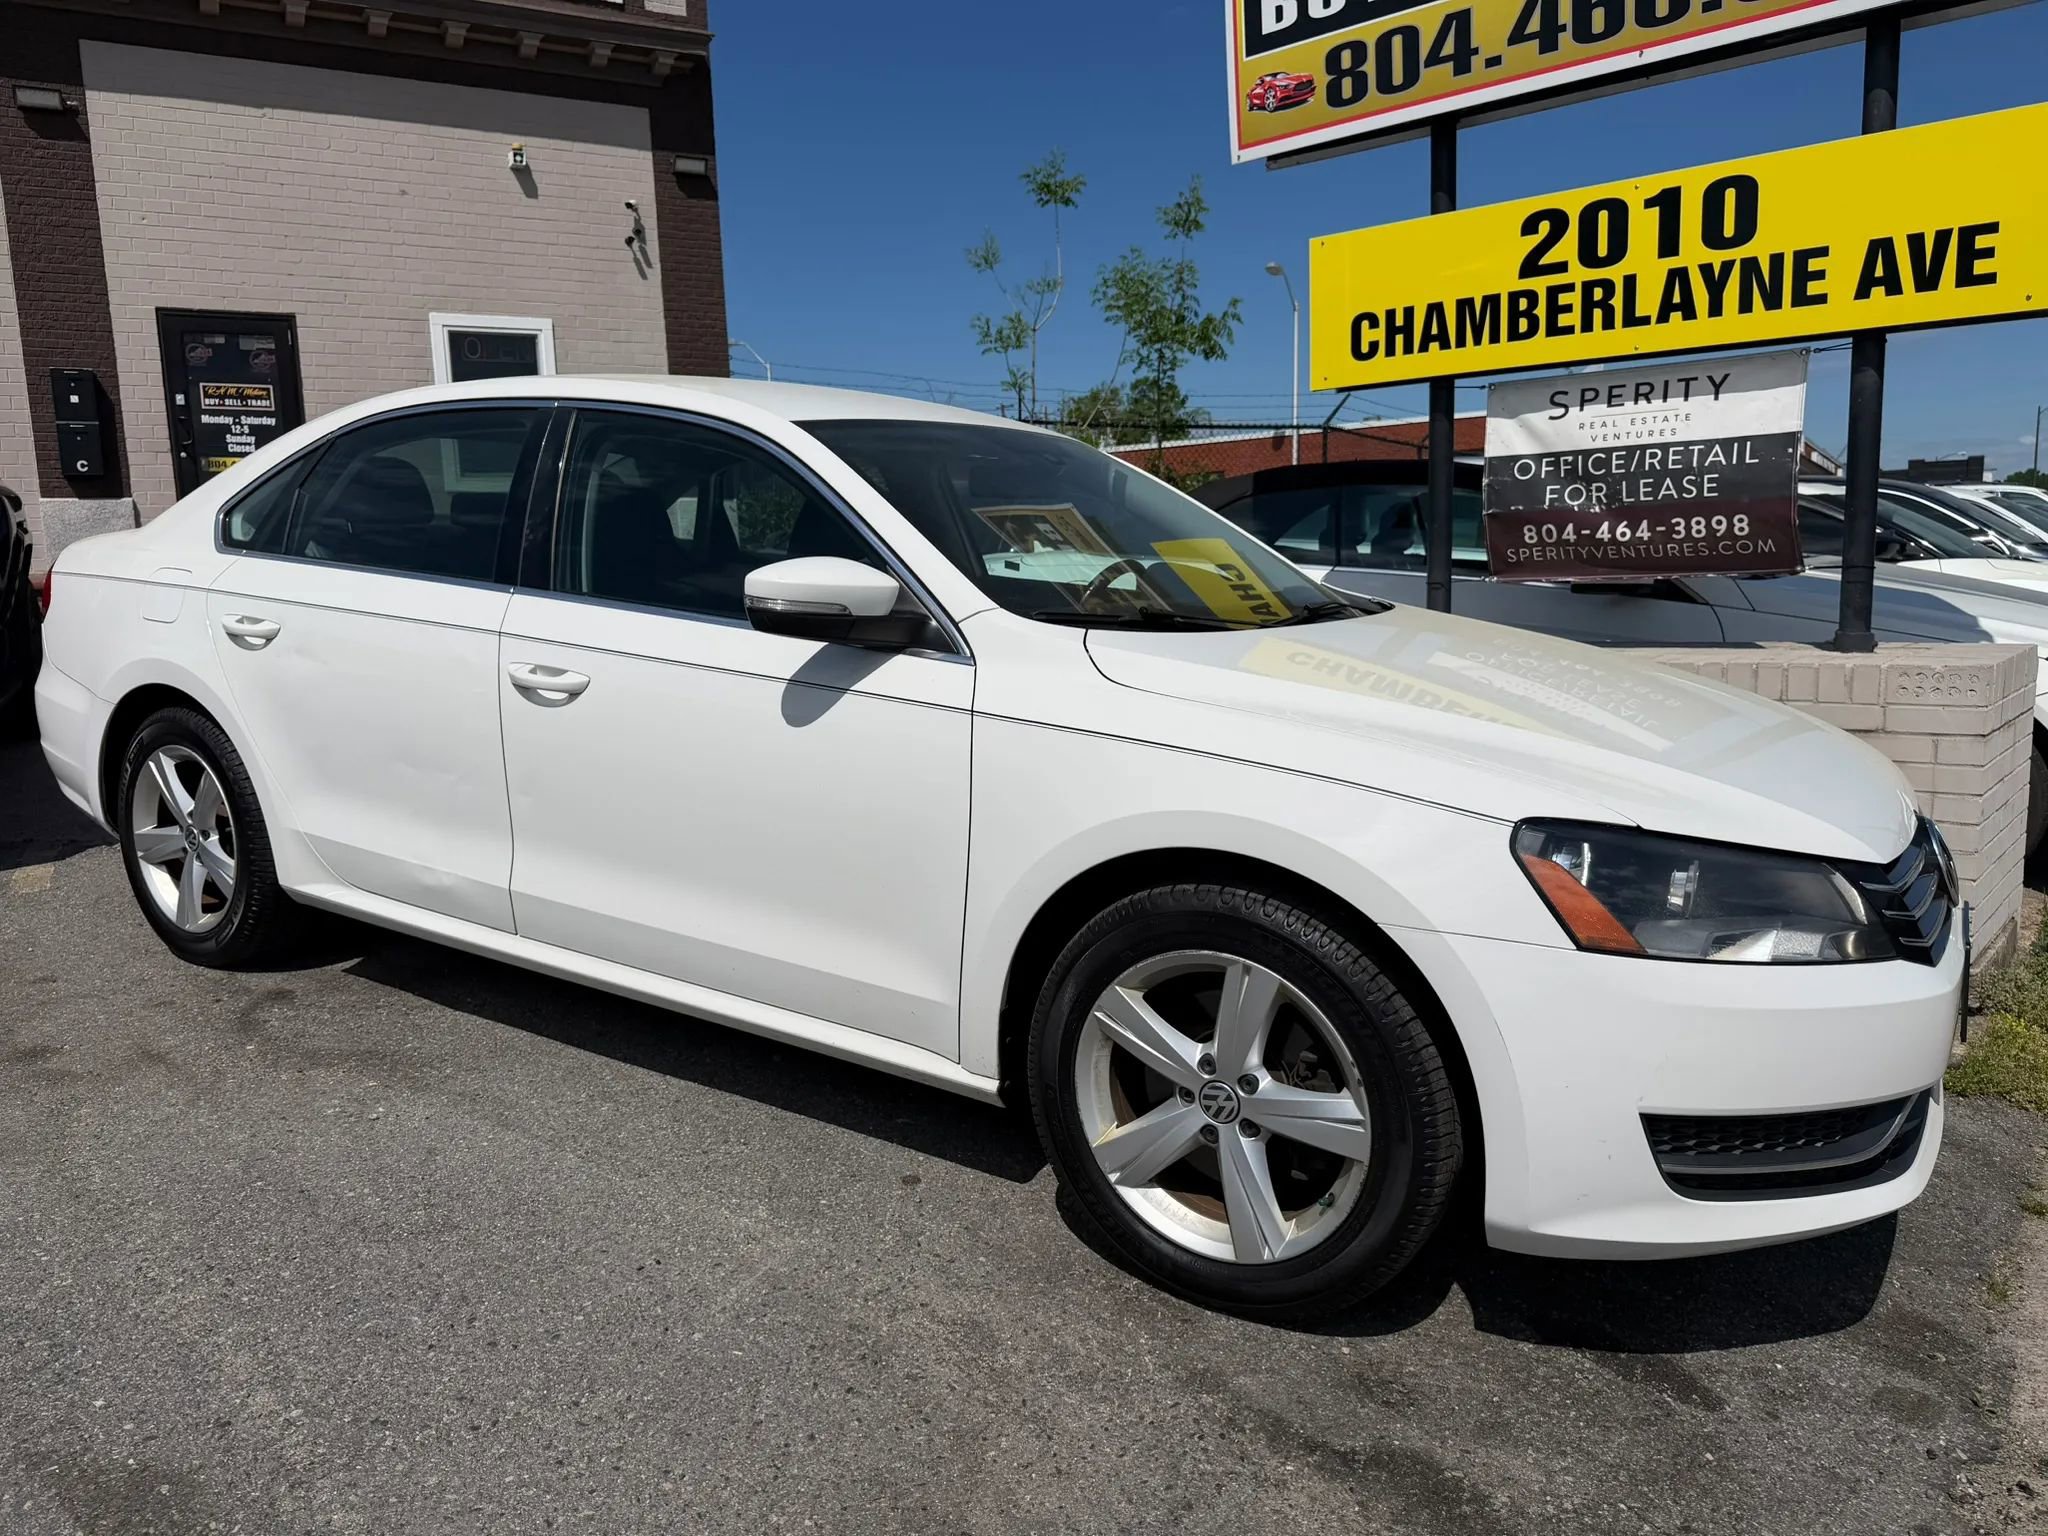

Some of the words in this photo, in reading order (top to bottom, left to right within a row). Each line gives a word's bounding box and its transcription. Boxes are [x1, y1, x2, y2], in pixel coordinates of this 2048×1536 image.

[1517, 174, 1760, 281] 2010
[1350, 245, 1830, 361] CHAMBERLAYNE
[1853, 221, 2000, 301] AVE
[204, 398, 220, 406] BUY
[224, 398, 242, 407] SELL
[247, 399, 272, 407] TRADE
[1547, 372, 1731, 421] SPERITY
[201, 414, 234, 425] Monday
[240, 415, 276, 426] Saturday
[230, 424, 250, 434] 12-5
[1578, 417, 1619, 431] REAL
[1630, 412, 1693, 426] ESTATE
[225, 433, 256, 444] Sunday
[1590, 427, 1679, 443] VENTURES
[227, 443, 256, 453] Closed
[76, 460, 89, 472] C
[1513, 441, 1760, 481] OFFICE/RETAIL
[1544, 483, 1608, 509] FOR
[1621, 473, 1720, 502] LEASE
[1522, 514, 1750, 545] 804-464-3898
[1506, 539, 1776, 562] SPERITYVENTURES.COM
